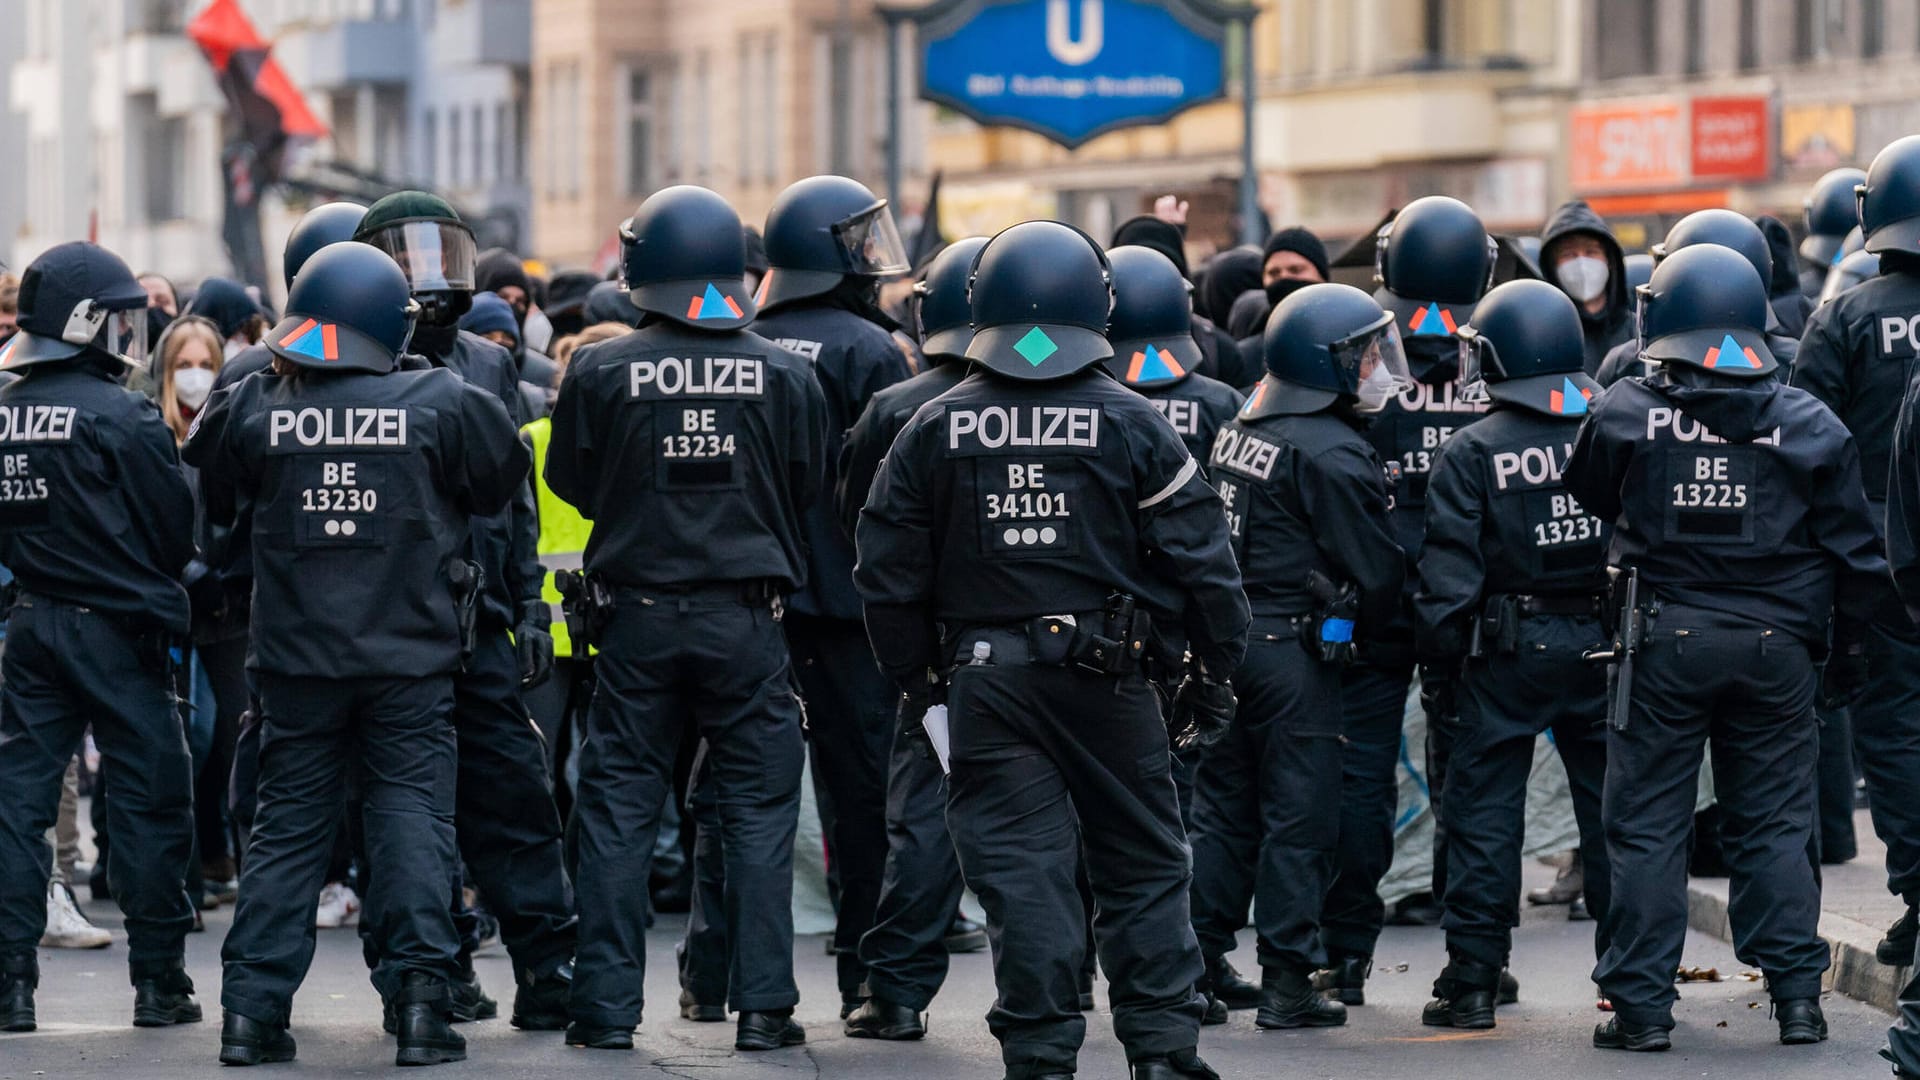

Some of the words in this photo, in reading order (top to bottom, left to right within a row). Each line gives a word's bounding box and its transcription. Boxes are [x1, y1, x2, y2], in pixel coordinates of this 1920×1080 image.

[1046, 0, 1104, 65] U
[630, 356, 764, 397] POLIZEI
[270, 407, 407, 446] POLIZEI
[683, 409, 716, 432] BE
[949, 405, 1099, 449] POLIZEI
[1646, 406, 1781, 448] POLI
[663, 434, 737, 457] 13234
[1208, 427, 1280, 480] POLIZEI
[4, 454, 28, 476] BE
[323, 462, 356, 486] BE
[1007, 463, 1044, 489] BE
[1695, 456, 1728, 481] BE
[0, 478, 49, 501] 3215
[302, 488, 377, 512] 13230
[1672, 483, 1747, 508] 13225
[986, 492, 1070, 519] 34101
[1551, 493, 1583, 518] BE
[1535, 515, 1602, 546] 13237
